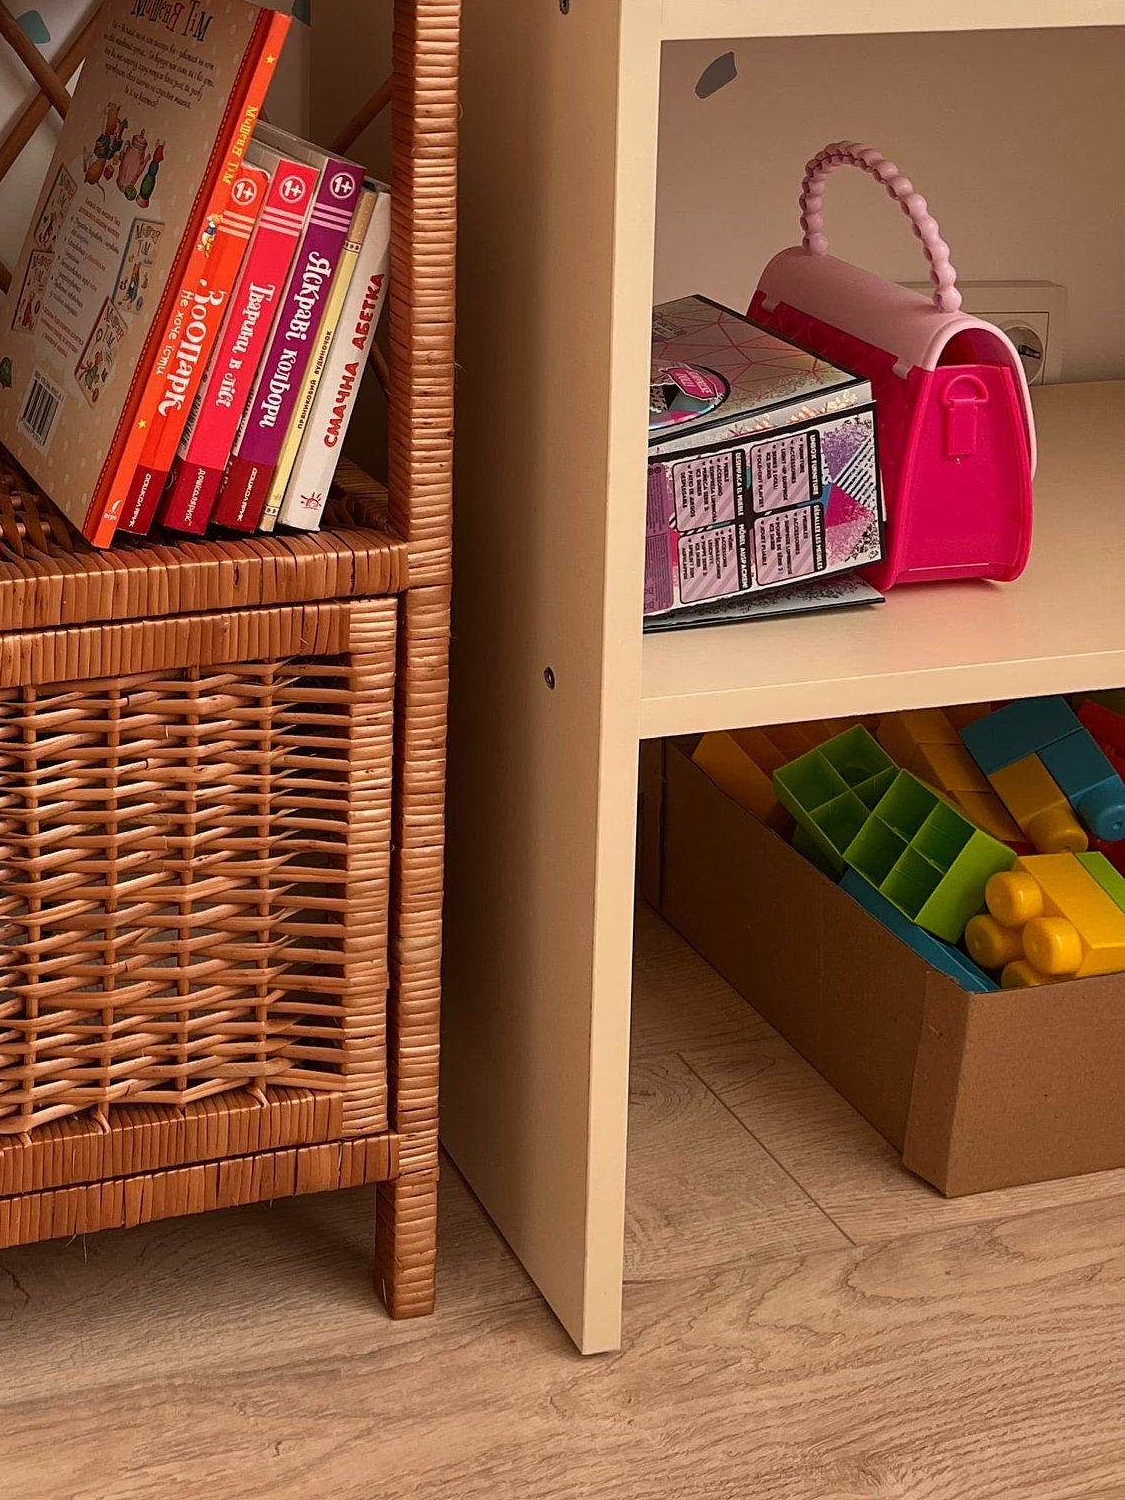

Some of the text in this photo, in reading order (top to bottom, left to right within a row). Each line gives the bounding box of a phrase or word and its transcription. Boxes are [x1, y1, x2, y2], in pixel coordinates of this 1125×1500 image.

[235, 182, 254, 200] 1+
[284, 180, 302, 200] 1+
[333, 176, 352, 194] 1+
[155, 289, 195, 375] Не хоче їсти
[232, 282, 276, 354] Тварини
[259, 251, 332, 428] Яскраві кольори
[324, 273, 385, 448] СМАЧНА АБЕТКА
[216, 372, 236, 408] лісі
